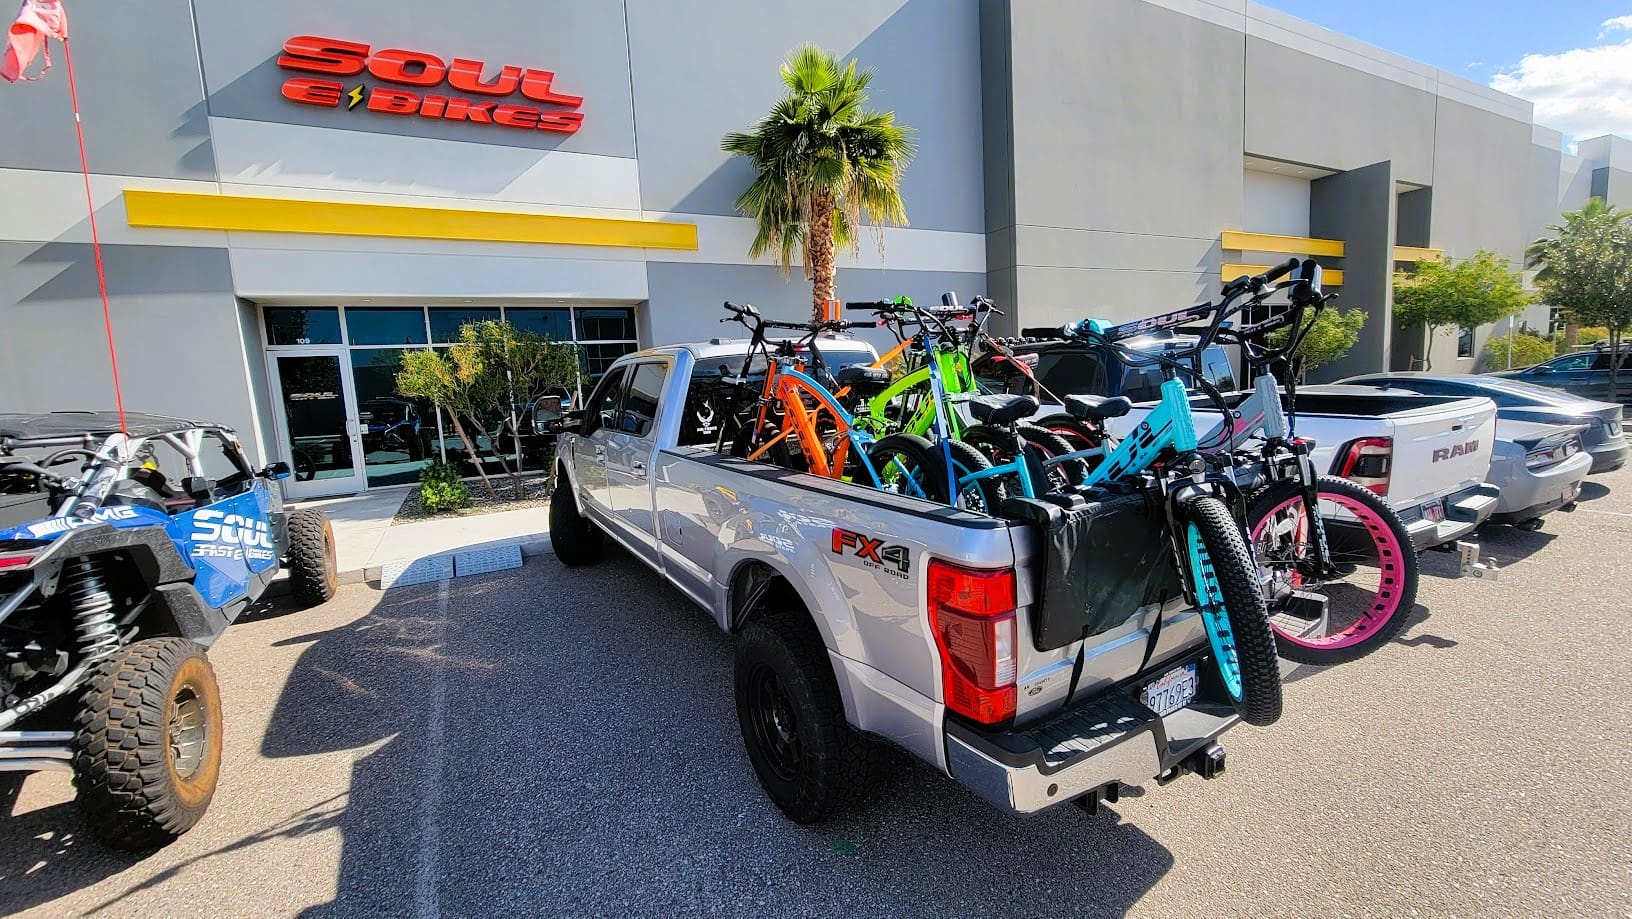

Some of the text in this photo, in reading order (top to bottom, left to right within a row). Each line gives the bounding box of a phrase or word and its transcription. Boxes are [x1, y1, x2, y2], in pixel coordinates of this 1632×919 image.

[277, 35, 583, 107] SOUL
[367, 86, 585, 133] BIKES
[1432, 440, 1480, 463] RAM
[191, 509, 273, 548] SOUL
[832, 528, 910, 573] FX4
[884, 567, 910, 580] ROAD
[1149, 676, 1195, 711] 97769E3
